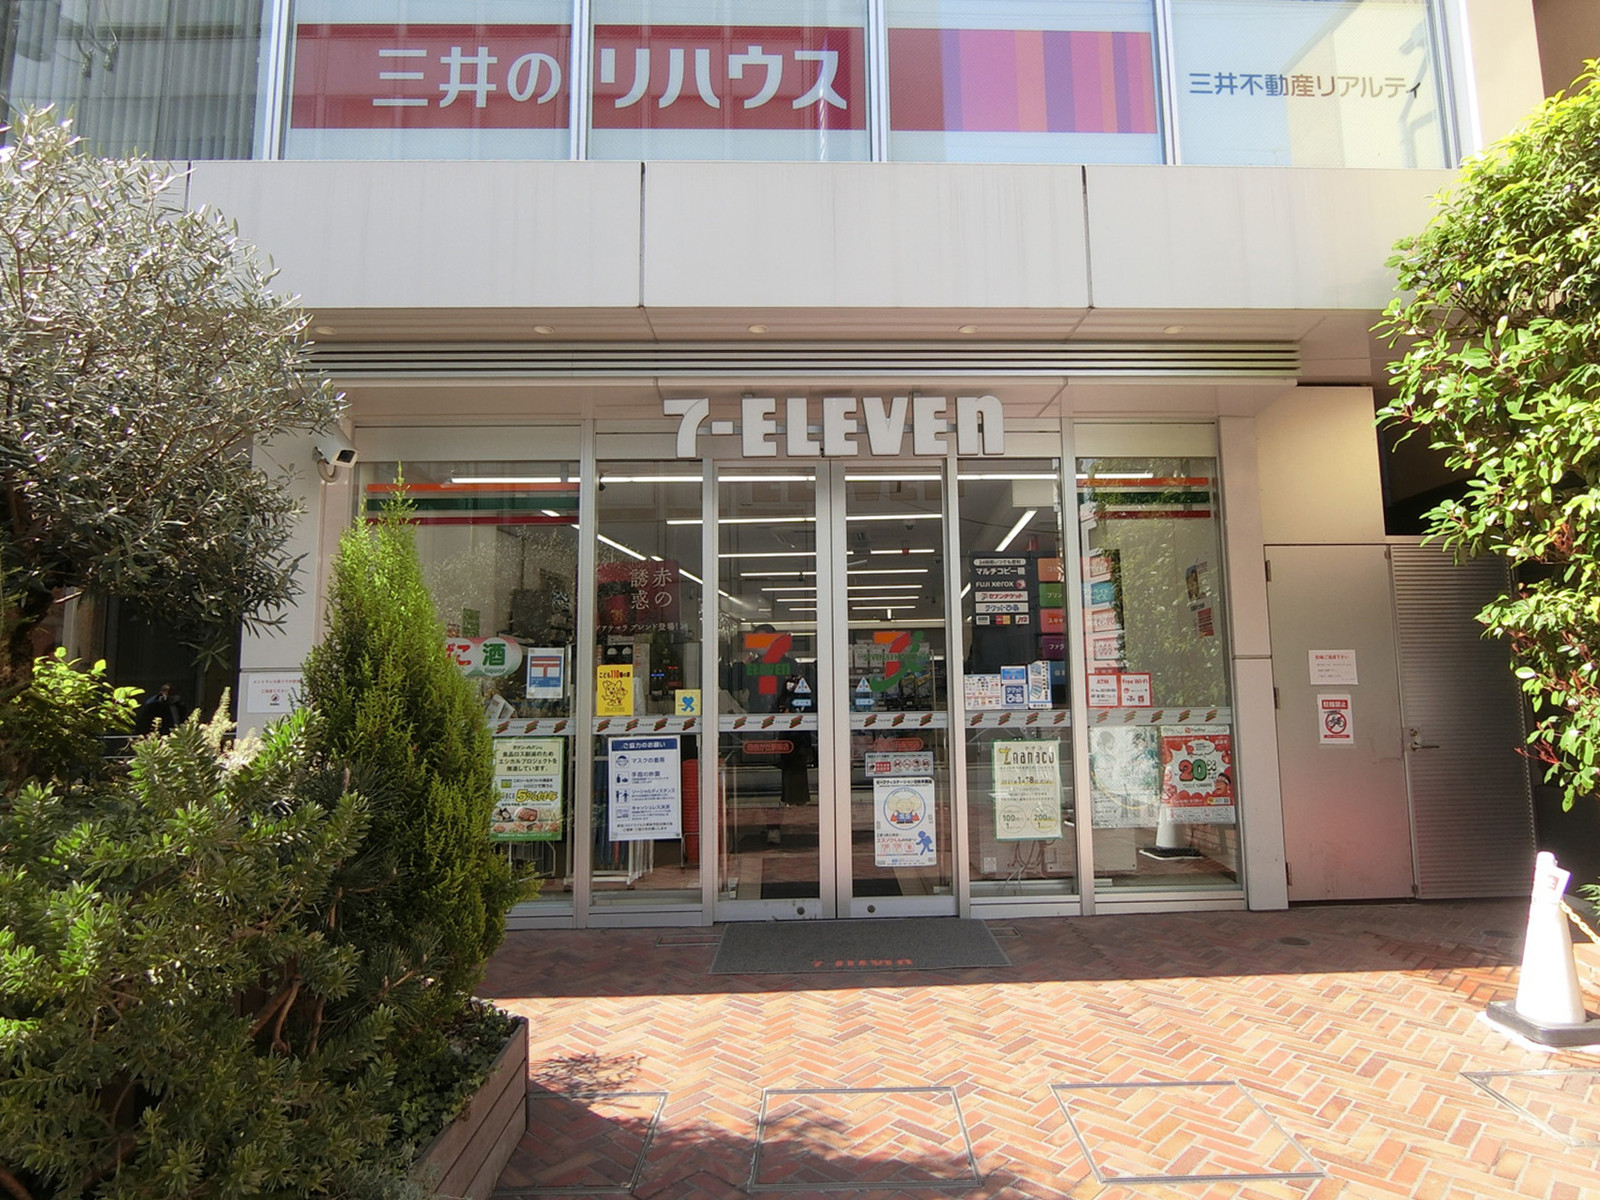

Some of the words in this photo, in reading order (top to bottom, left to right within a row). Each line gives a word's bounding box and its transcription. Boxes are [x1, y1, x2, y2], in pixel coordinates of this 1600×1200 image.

[372, 46, 847, 110] 三井のリハウス
[1188, 72, 1422, 98] 三井不動産リアルティ
[976, 567, 1026, 575] マルチコピー機
[629, 568, 650, 610] 誘惑
[652, 567, 672, 608] 赤の
[482, 643, 506, 667] 酒
[1012, 752, 1055, 764] nanaco
